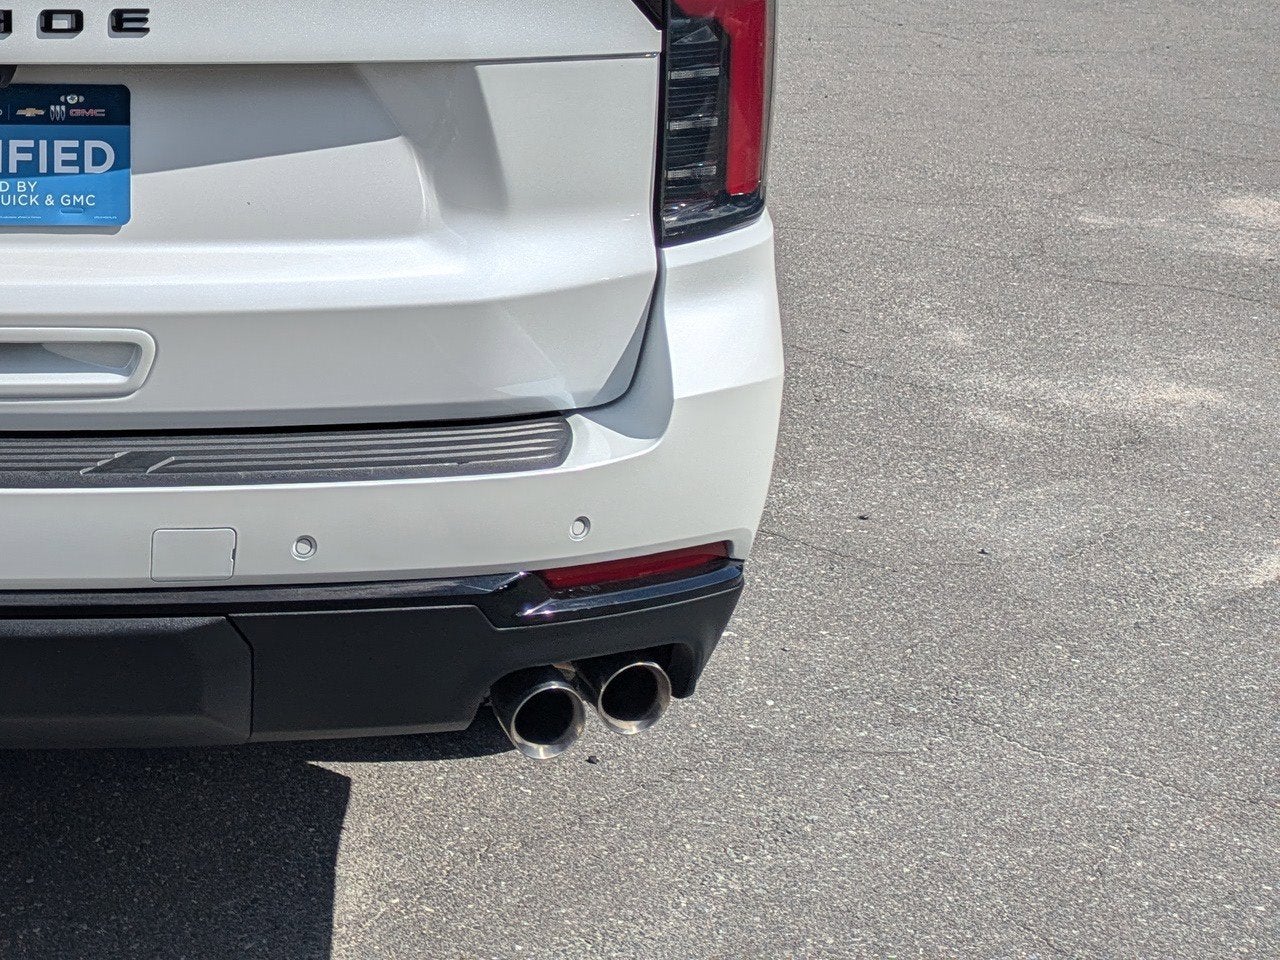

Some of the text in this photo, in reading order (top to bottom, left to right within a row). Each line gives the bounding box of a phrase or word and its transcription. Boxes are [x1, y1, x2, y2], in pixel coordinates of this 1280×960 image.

[69, 108, 106, 117] GMC
[16, 180, 38, 193] BY
[44, 194, 55, 207] &
[60, 194, 96, 207] GMC
